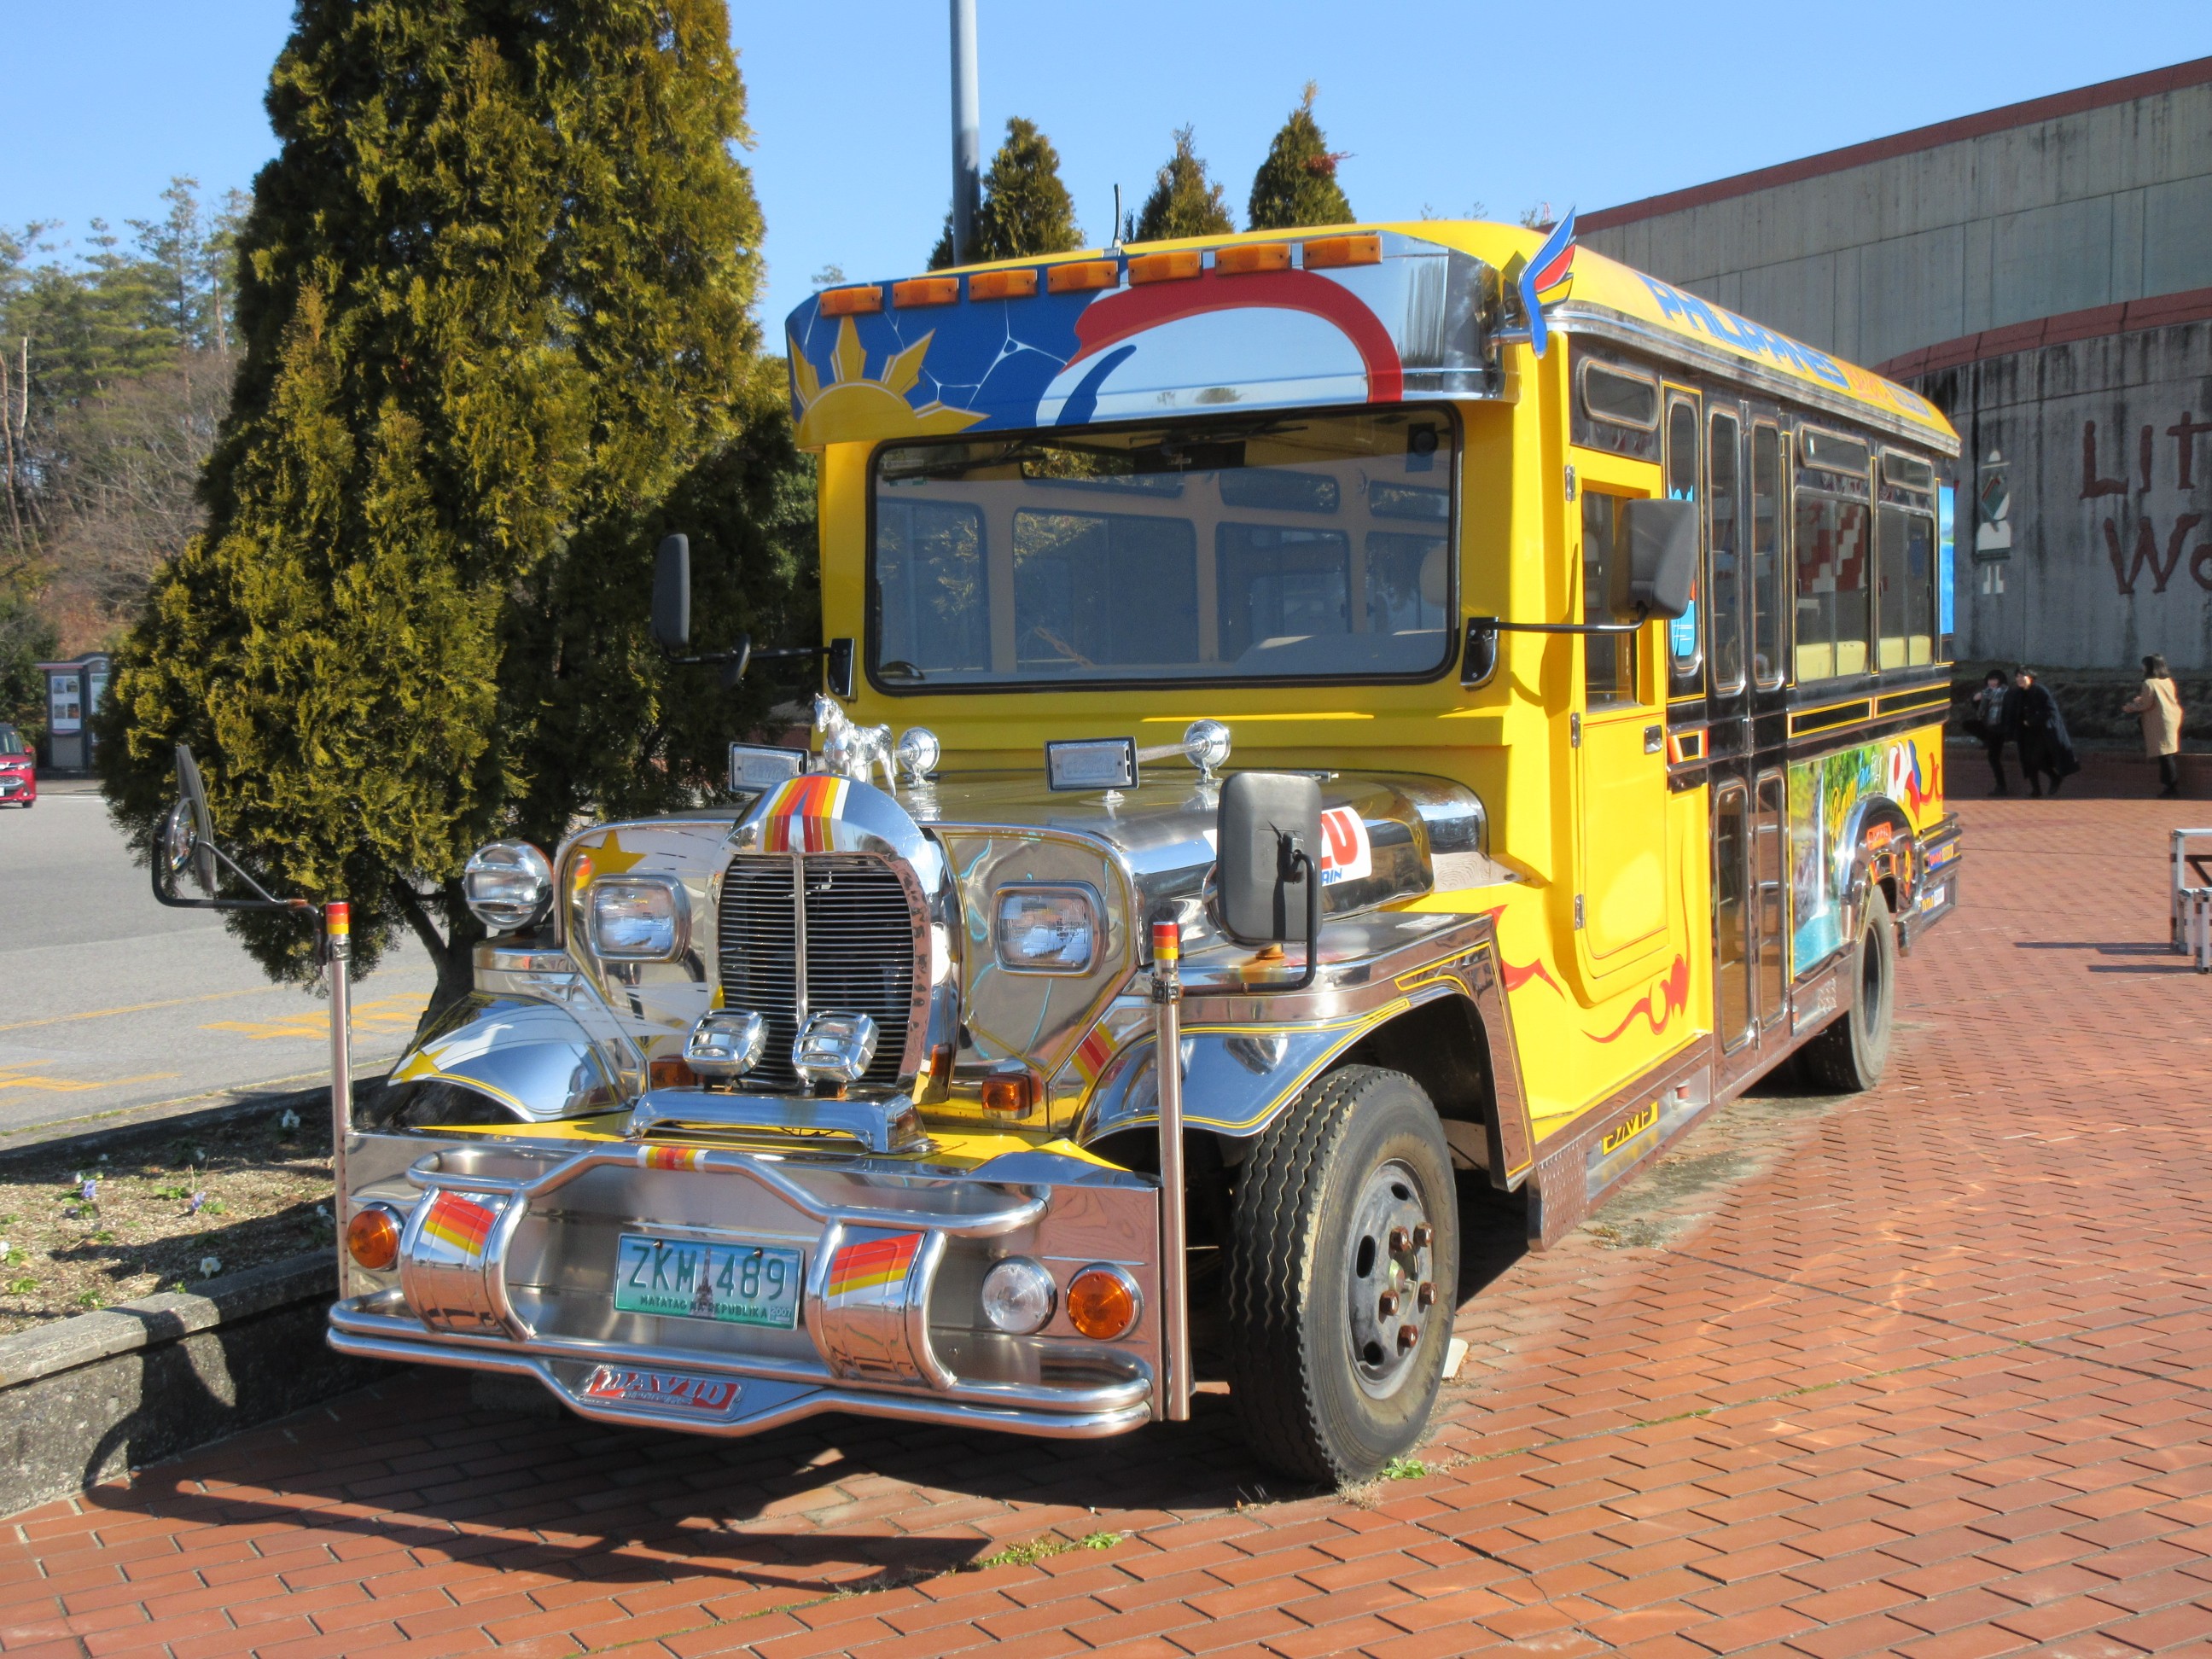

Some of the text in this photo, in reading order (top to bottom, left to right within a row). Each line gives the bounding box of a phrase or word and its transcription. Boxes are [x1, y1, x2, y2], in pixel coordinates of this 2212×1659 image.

[1633, 271, 1850, 390] PHILIPPINES
[1605, 1103, 1653, 1150] DAVID
[629, 1245, 787, 1301] ZKM 489
[640, 1295, 687, 1310] MATATAG
[707, 1302, 767, 1318] REPUBLIKA
[770, 1307, 792, 1317] 2007
[597, 1369, 729, 1406] DAVID
